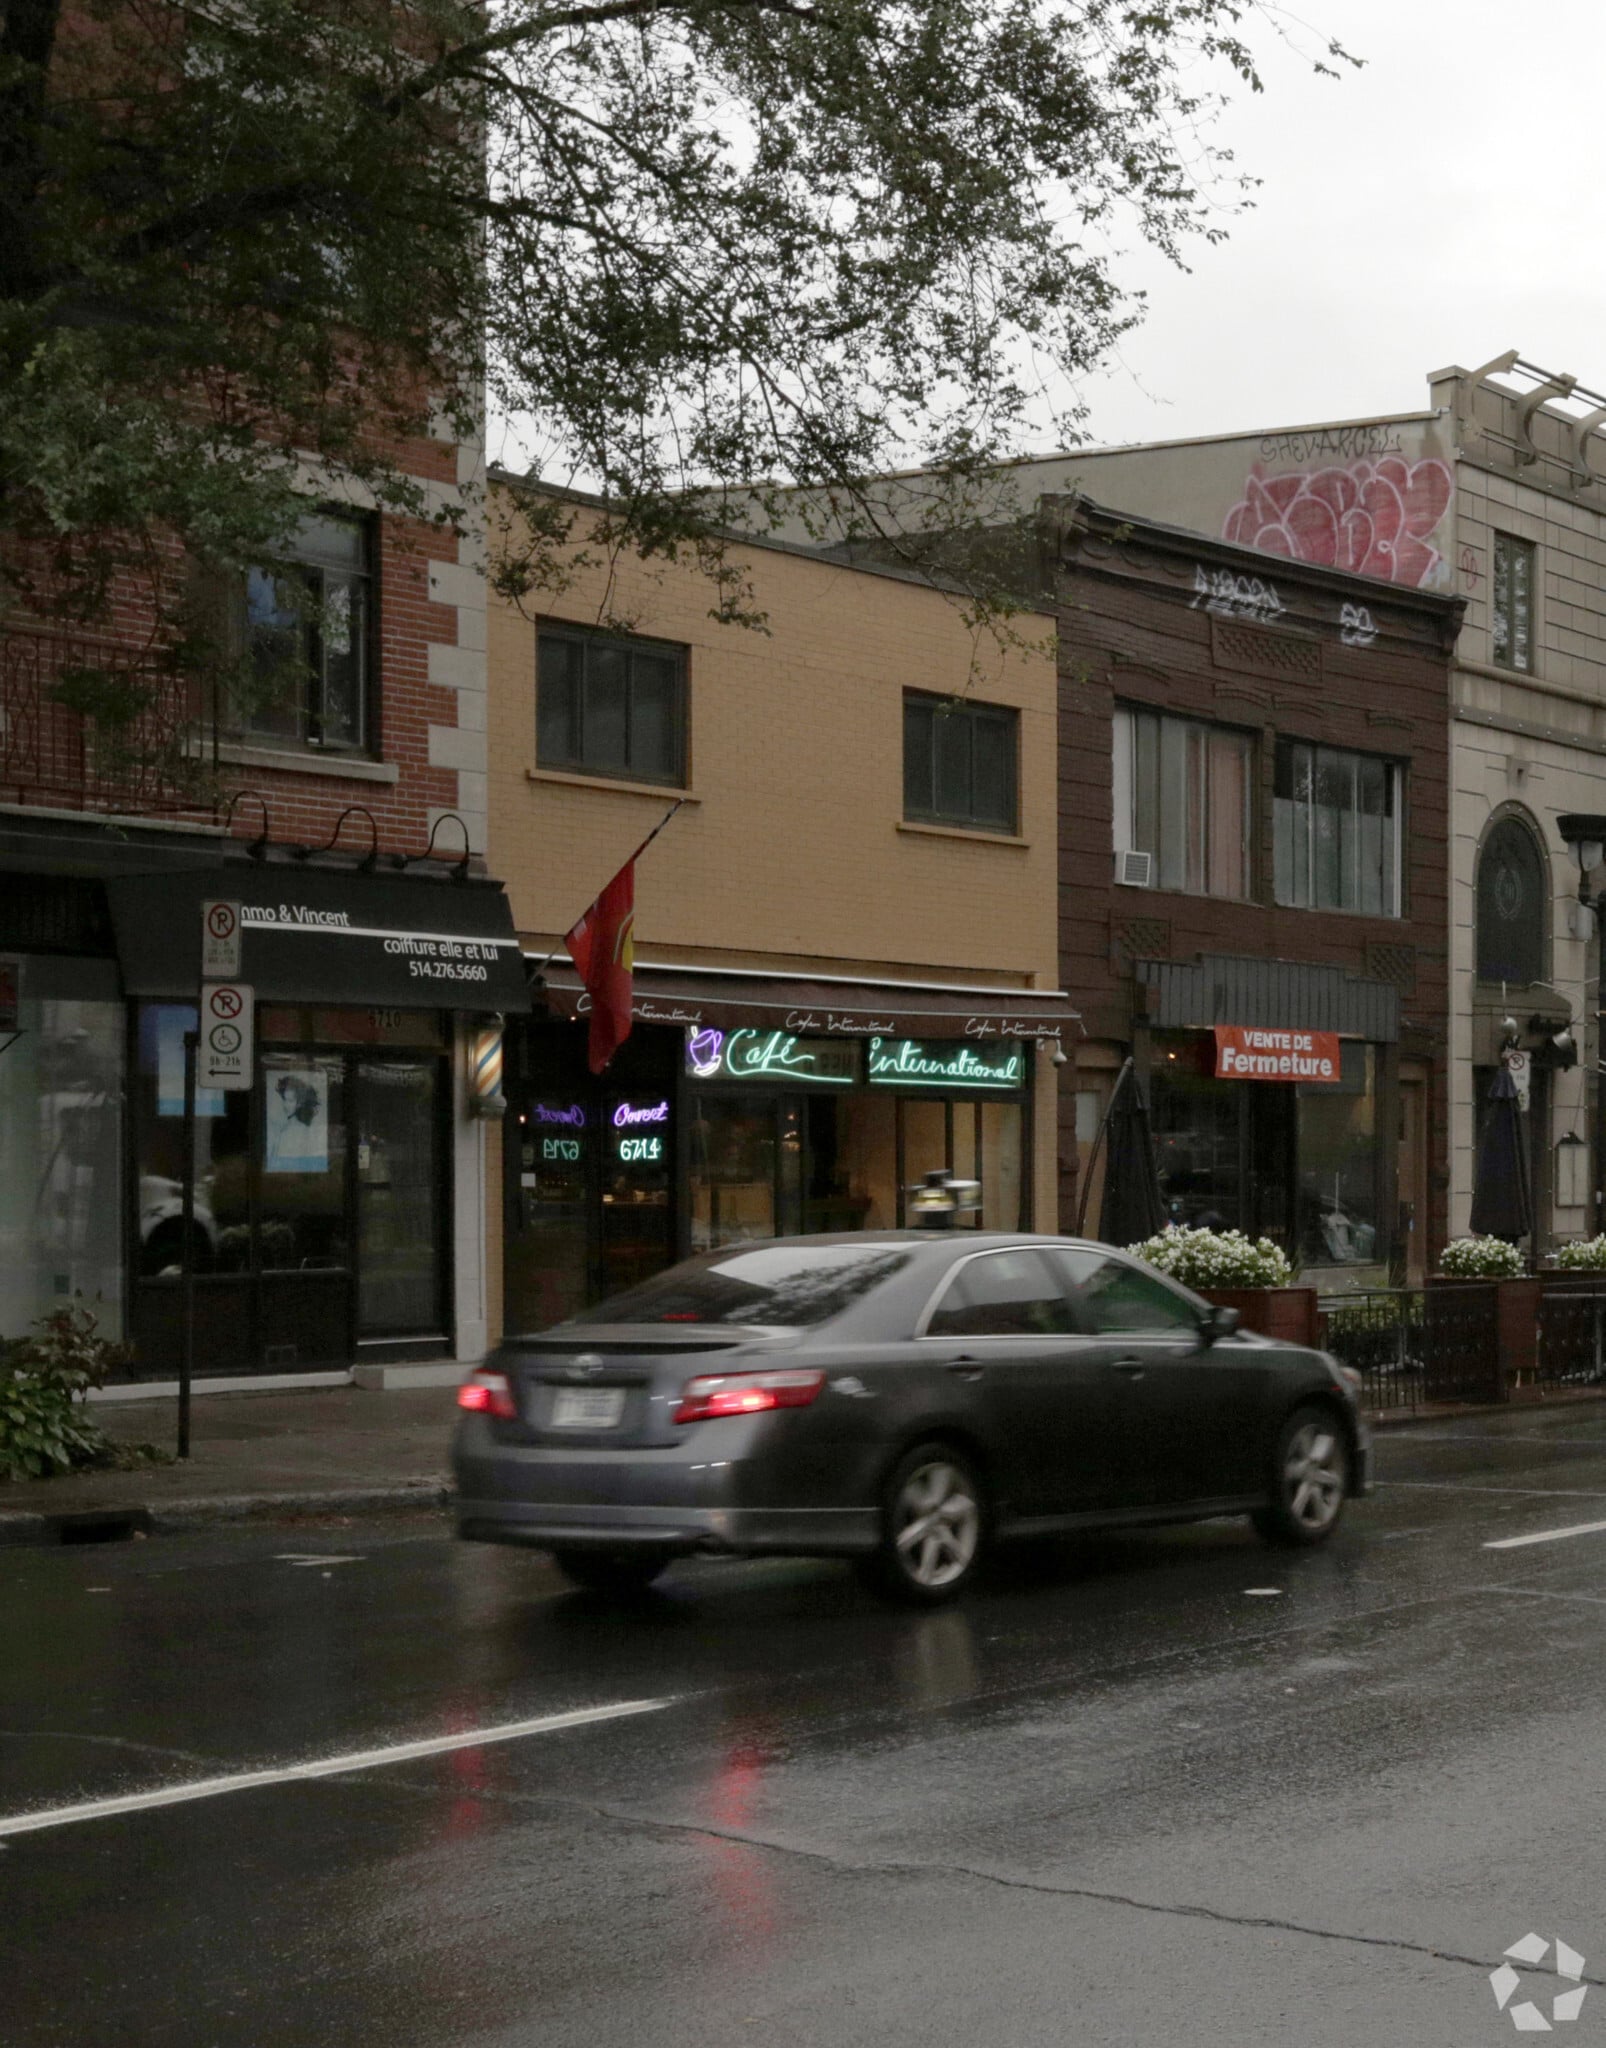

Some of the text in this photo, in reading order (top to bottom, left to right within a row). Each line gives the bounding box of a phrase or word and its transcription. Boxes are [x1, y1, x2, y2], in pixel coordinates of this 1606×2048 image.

[279, 904, 292, 922] &
[292, 905, 350, 927] Vincent
[384, 937, 499, 960] coiffure elle et lui
[409, 960, 487, 981] 514.276.5660
[727, 1028, 816, 1076] Café
[1243, 1030, 1313, 1051] VENTE DE
[1221, 1047, 1333, 1077] Fermeture
[614, 1101, 669, 1127] Ouvert
